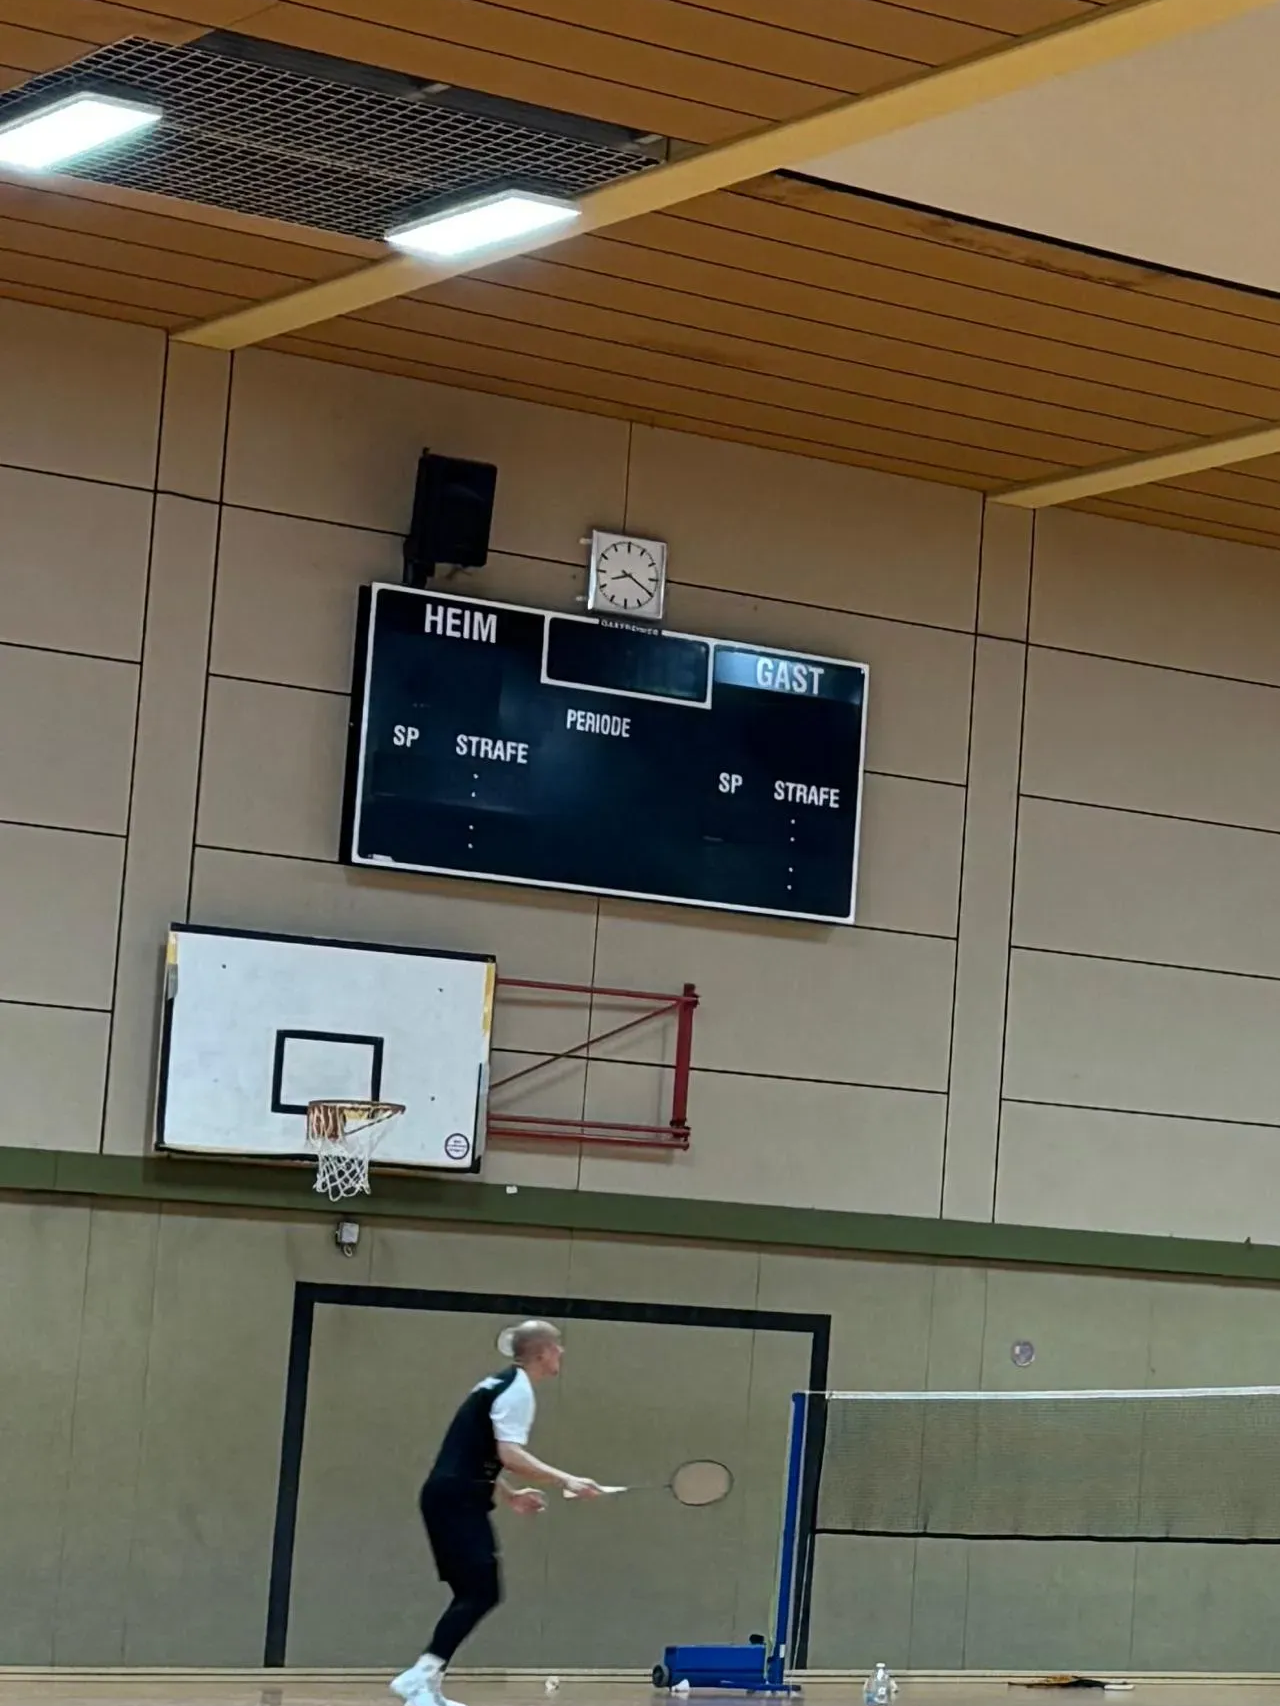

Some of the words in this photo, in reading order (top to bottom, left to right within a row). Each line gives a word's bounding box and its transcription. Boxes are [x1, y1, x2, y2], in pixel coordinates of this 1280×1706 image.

[424, 603, 498, 643] HEIM
[756, 656, 825, 696] GAST
[566, 708, 632, 738] PERIODE
[393, 724, 420, 748] SP
[455, 734, 529, 764] STRAFE
[718, 772, 743, 794] SP
[773, 780, 840, 808] STRAFE
